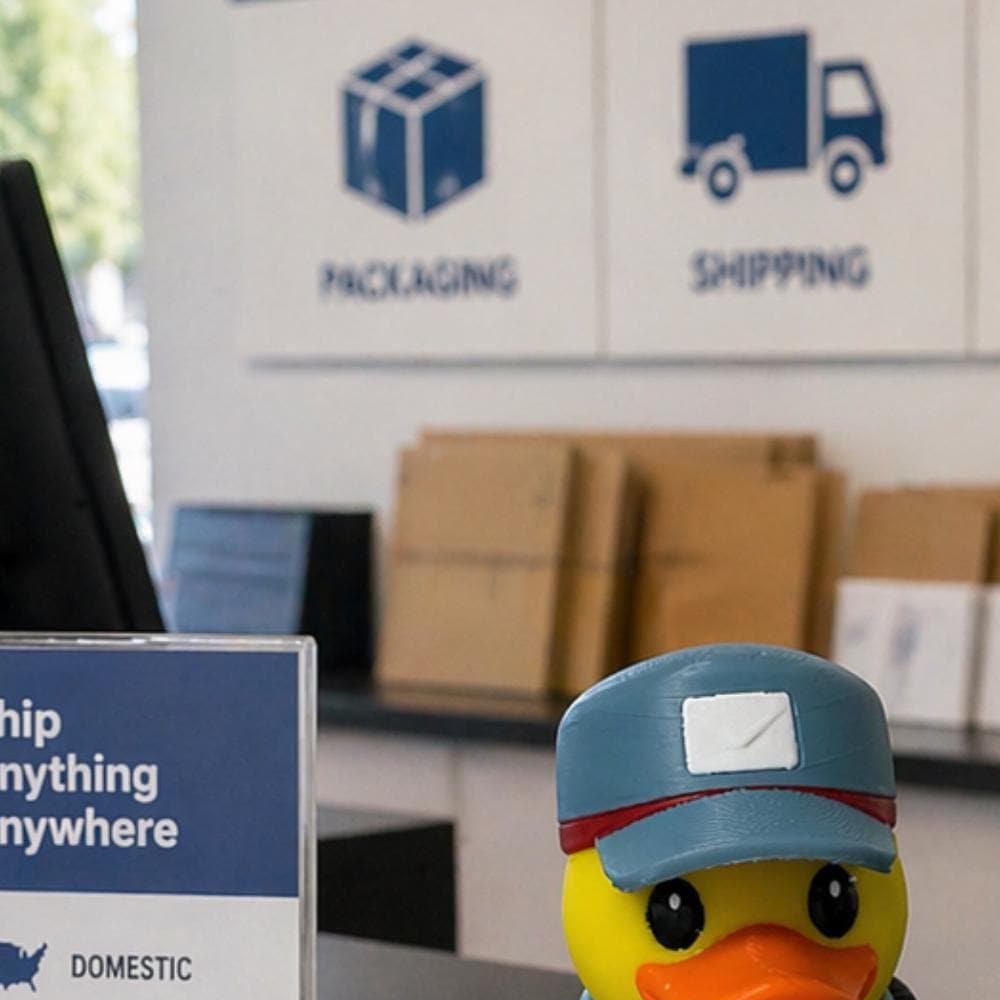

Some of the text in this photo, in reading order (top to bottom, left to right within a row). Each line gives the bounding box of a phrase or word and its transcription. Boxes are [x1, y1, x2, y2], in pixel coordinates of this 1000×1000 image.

[319, 256, 519, 301] PACKAGING
[691, 246, 871, 293] SHIPPING
[0, 698, 61, 748] hip
[0, 753, 158, 804] nything
[0, 806, 179, 856] nywhere
[71, 954, 193, 982] DOMESTIC
